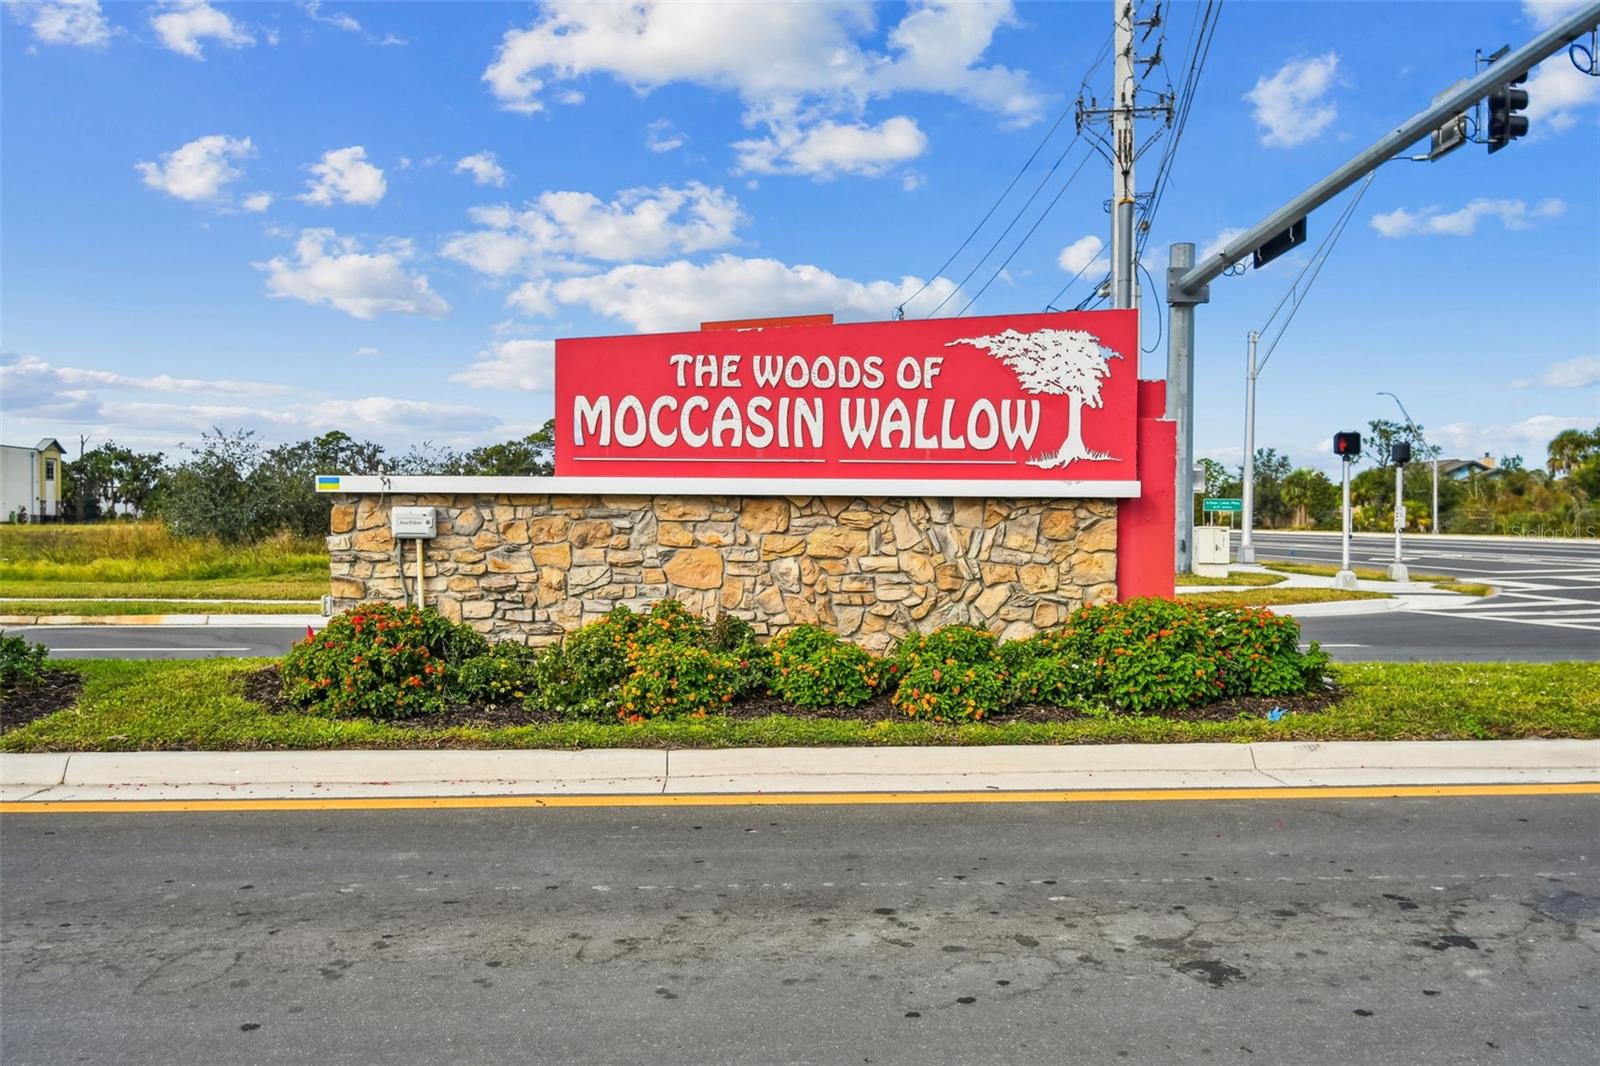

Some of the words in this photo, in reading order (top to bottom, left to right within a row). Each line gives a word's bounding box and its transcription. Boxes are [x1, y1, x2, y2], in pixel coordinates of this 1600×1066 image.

[669, 353, 742, 388] THE
[752, 355, 885, 389] WOODS
[896, 356, 944, 390] OF
[573, 394, 824, 449] MOCCASIN
[840, 397, 1041, 451] WALLOW
